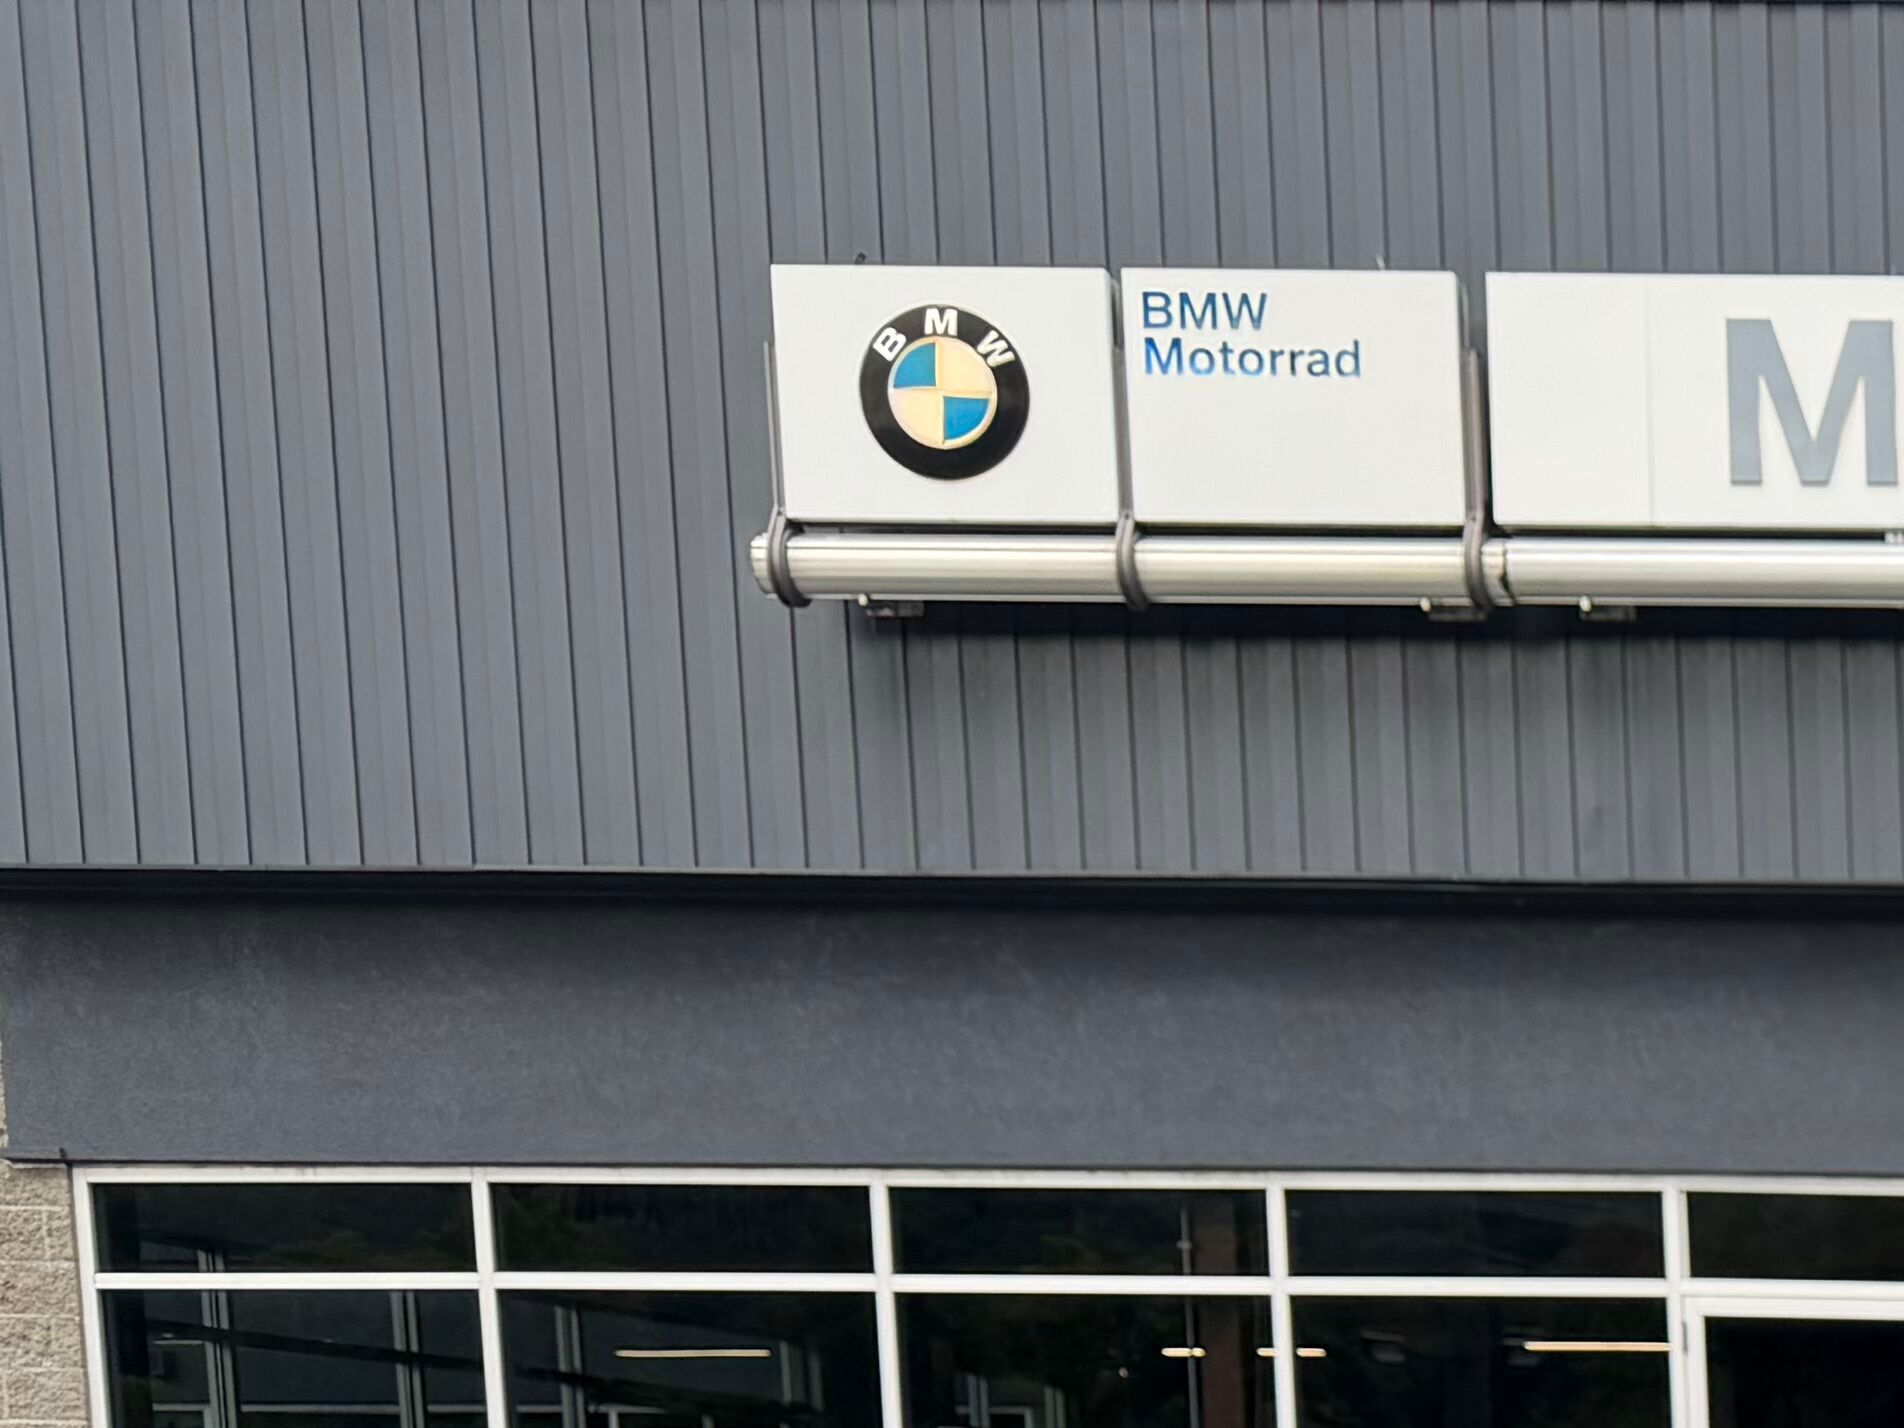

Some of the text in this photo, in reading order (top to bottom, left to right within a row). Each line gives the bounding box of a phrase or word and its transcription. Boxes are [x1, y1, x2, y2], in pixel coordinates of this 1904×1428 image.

[1141, 291, 1268, 332] BMW
[873, 308, 1015, 367] BMW
[1143, 338, 1361, 378] Motorrad
